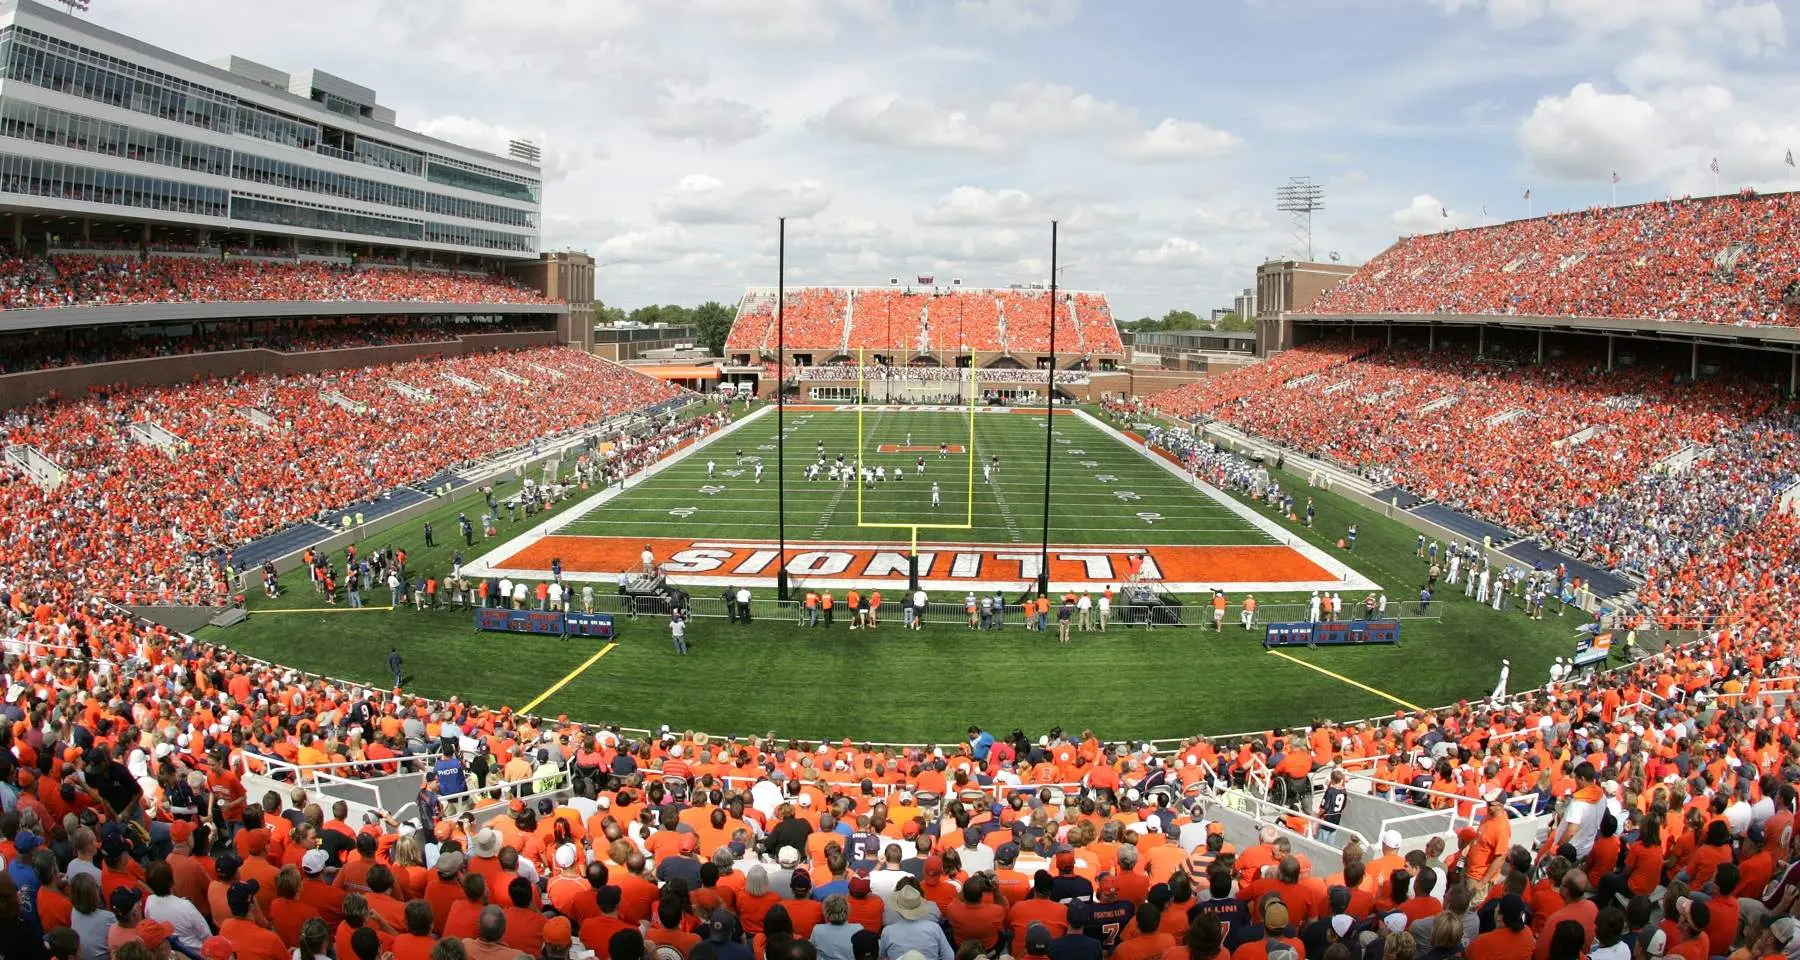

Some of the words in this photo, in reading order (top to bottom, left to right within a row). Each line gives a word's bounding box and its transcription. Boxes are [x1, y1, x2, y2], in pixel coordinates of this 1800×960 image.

[658, 548, 1165, 580] ILLINOIS
[361, 704, 369, 720] 9
[1334, 793, 1345, 812] 9
[853, 842, 866, 861] 5
[1102, 923, 1119, 945] 7
